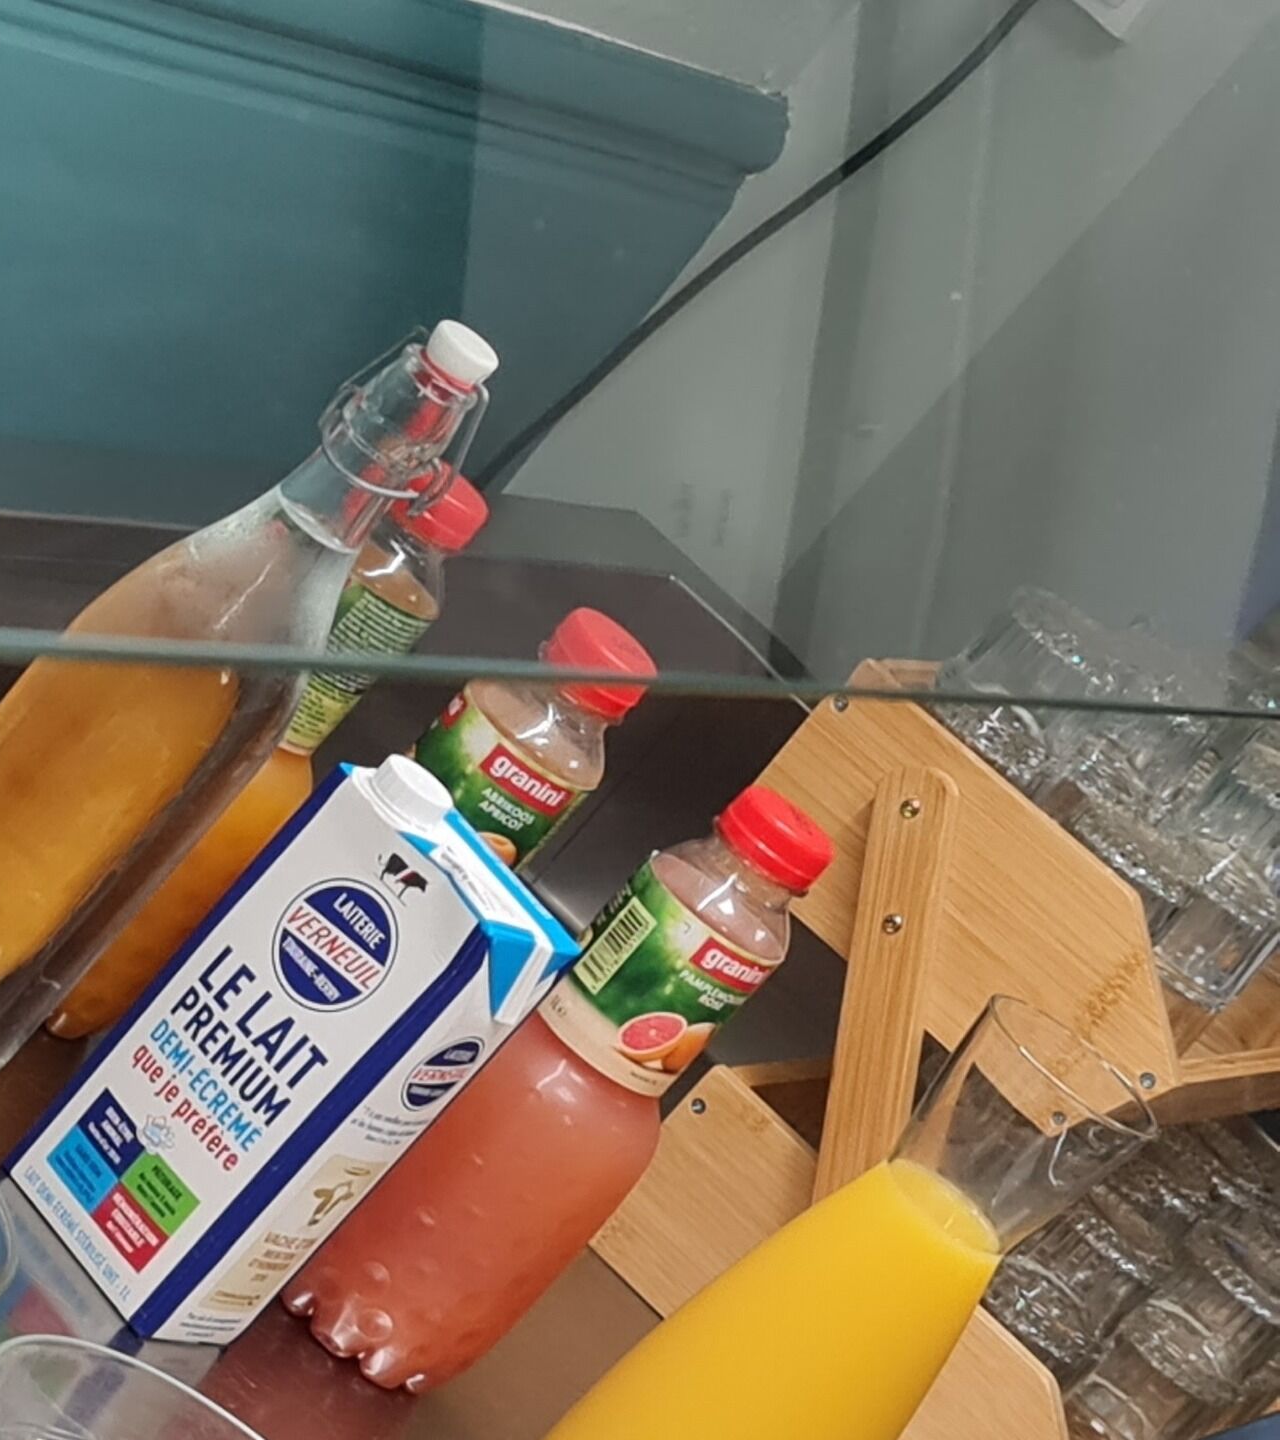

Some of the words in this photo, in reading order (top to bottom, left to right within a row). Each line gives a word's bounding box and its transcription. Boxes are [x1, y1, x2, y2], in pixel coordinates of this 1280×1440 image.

[490, 756, 567, 807] granini
[285, 904, 382, 991] VERNEUIL
[333, 892, 386, 951] LAITERIE
[170, 985, 292, 1127] PREMIUM
[198, 944, 257, 1013] LE
[236, 990, 329, 1090] LAIT
[132, 1044, 164, 1084] que
[154, 1073, 180, 1103] je
[171, 1097, 239, 1172] préfère
